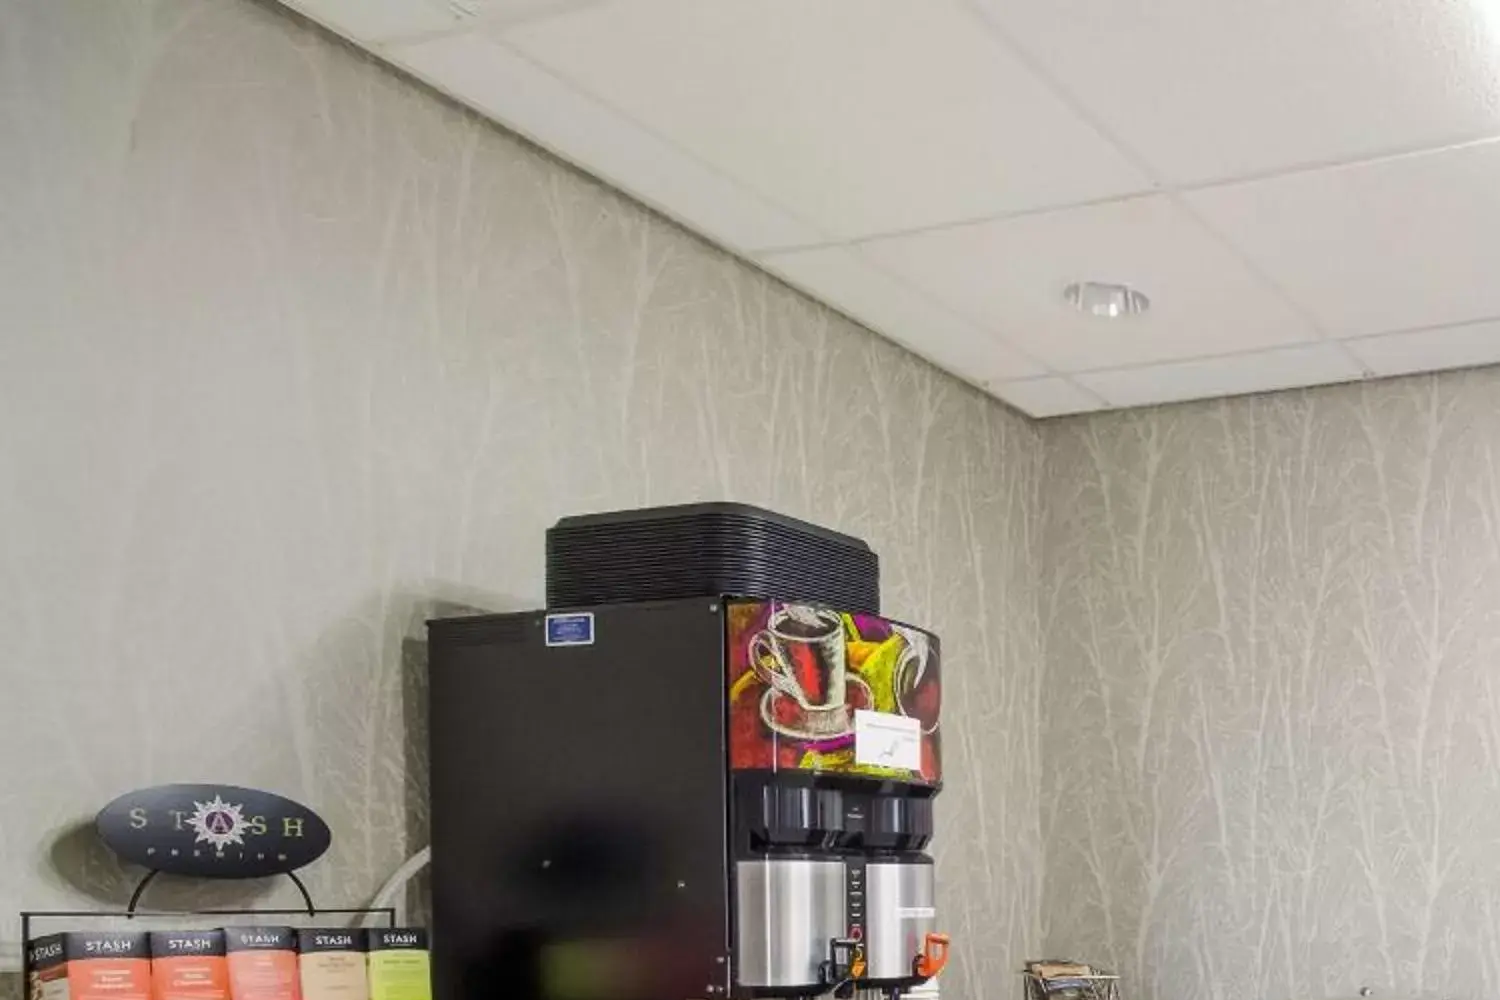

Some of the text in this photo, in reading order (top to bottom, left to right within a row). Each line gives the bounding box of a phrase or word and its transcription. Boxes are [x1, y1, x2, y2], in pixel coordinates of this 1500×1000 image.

[129, 808, 304, 837] STASH
[168, 938, 211, 949] STASH
[240, 934, 280, 944] STASH
[315, 935, 353, 945] STASH
[383, 933, 417, 944] STASH
[85, 940, 132, 951] STASH
